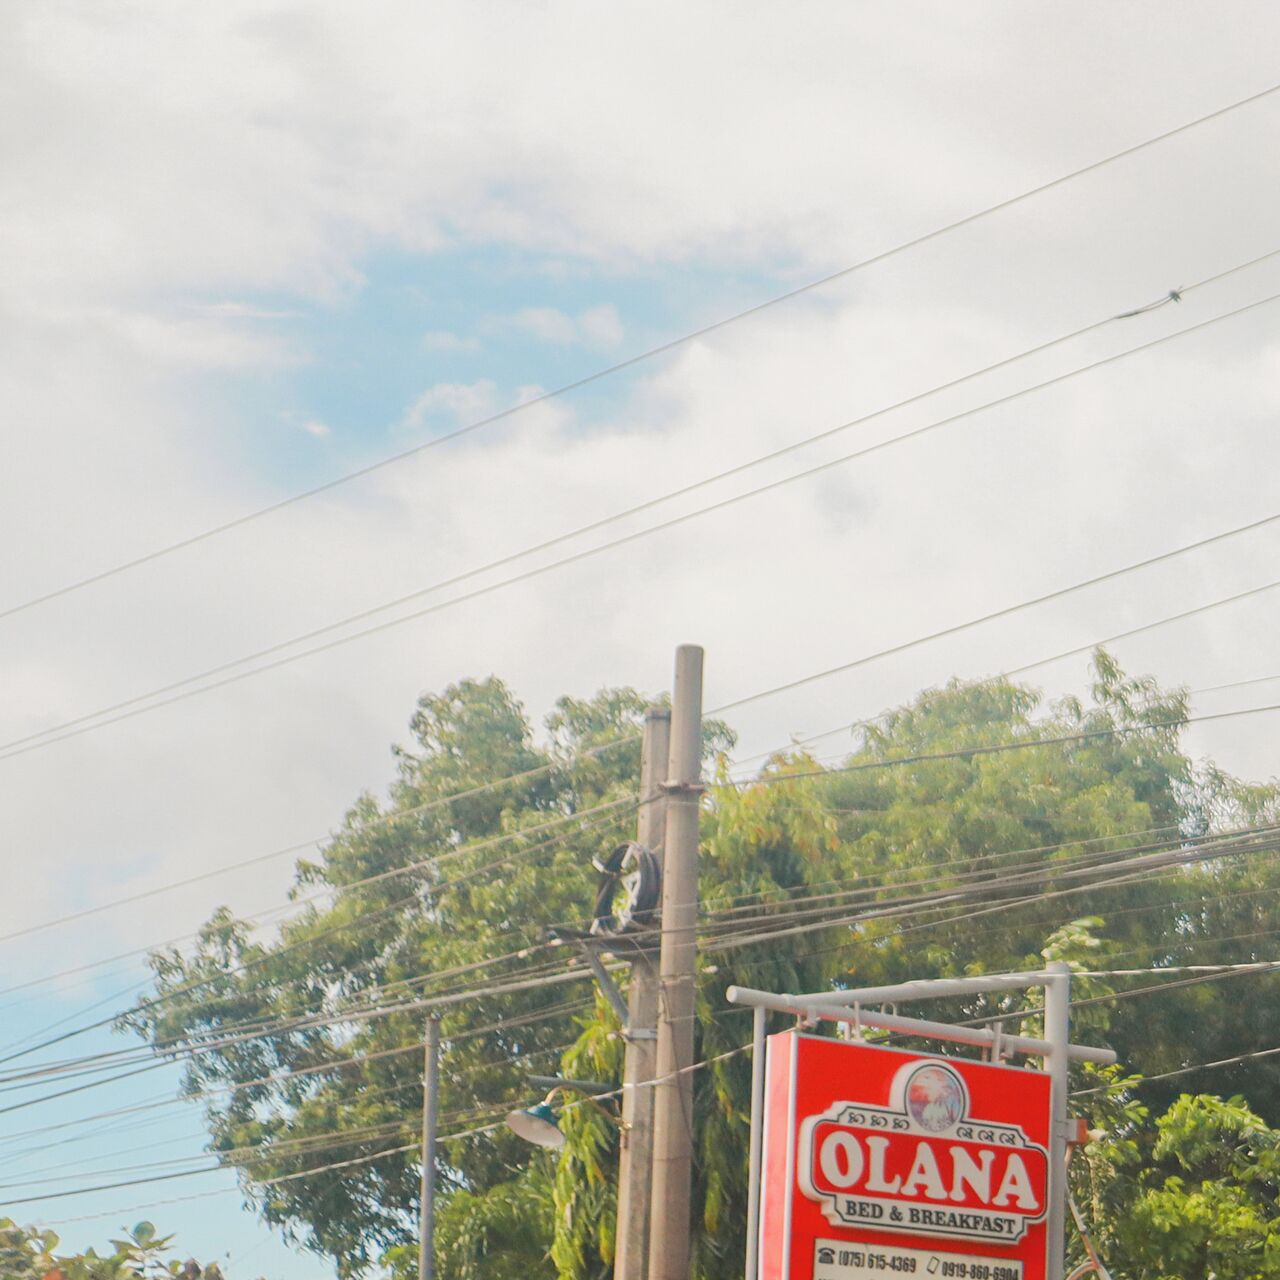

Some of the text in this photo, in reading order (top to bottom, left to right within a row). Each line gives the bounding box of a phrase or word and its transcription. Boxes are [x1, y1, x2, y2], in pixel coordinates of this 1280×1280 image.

[820, 1131, 1039, 1210] OLANA
[845, 1200, 1016, 1236] BED & BREAKFAST
[867, 1254, 917, 1274] 615-4369
